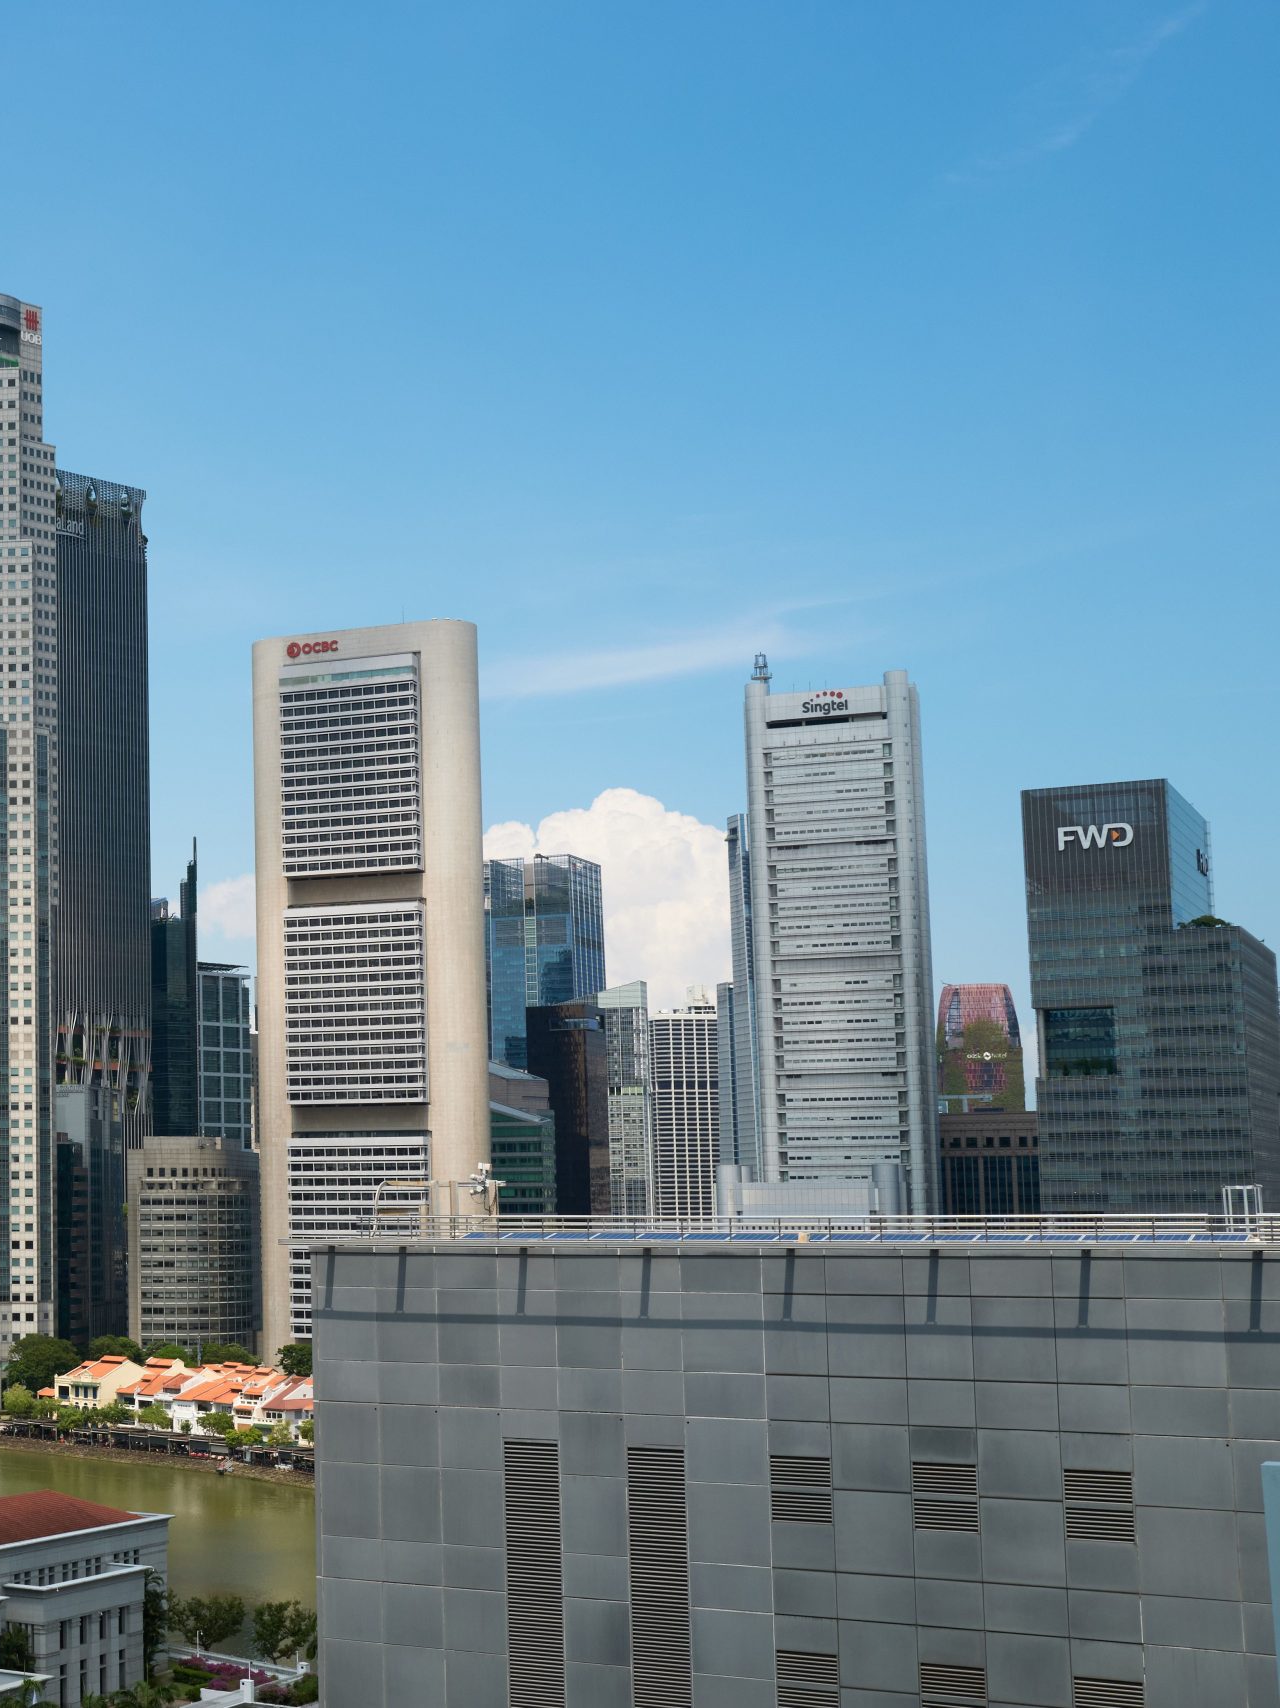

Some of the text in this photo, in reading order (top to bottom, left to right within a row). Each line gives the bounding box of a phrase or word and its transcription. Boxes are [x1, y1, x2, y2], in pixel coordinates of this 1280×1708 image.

[20, 330, 42, 345] UOB
[301, 640, 339, 655] OCBC
[802, 698, 848, 715] Singtel
[1057, 822, 1134, 851] FWD
